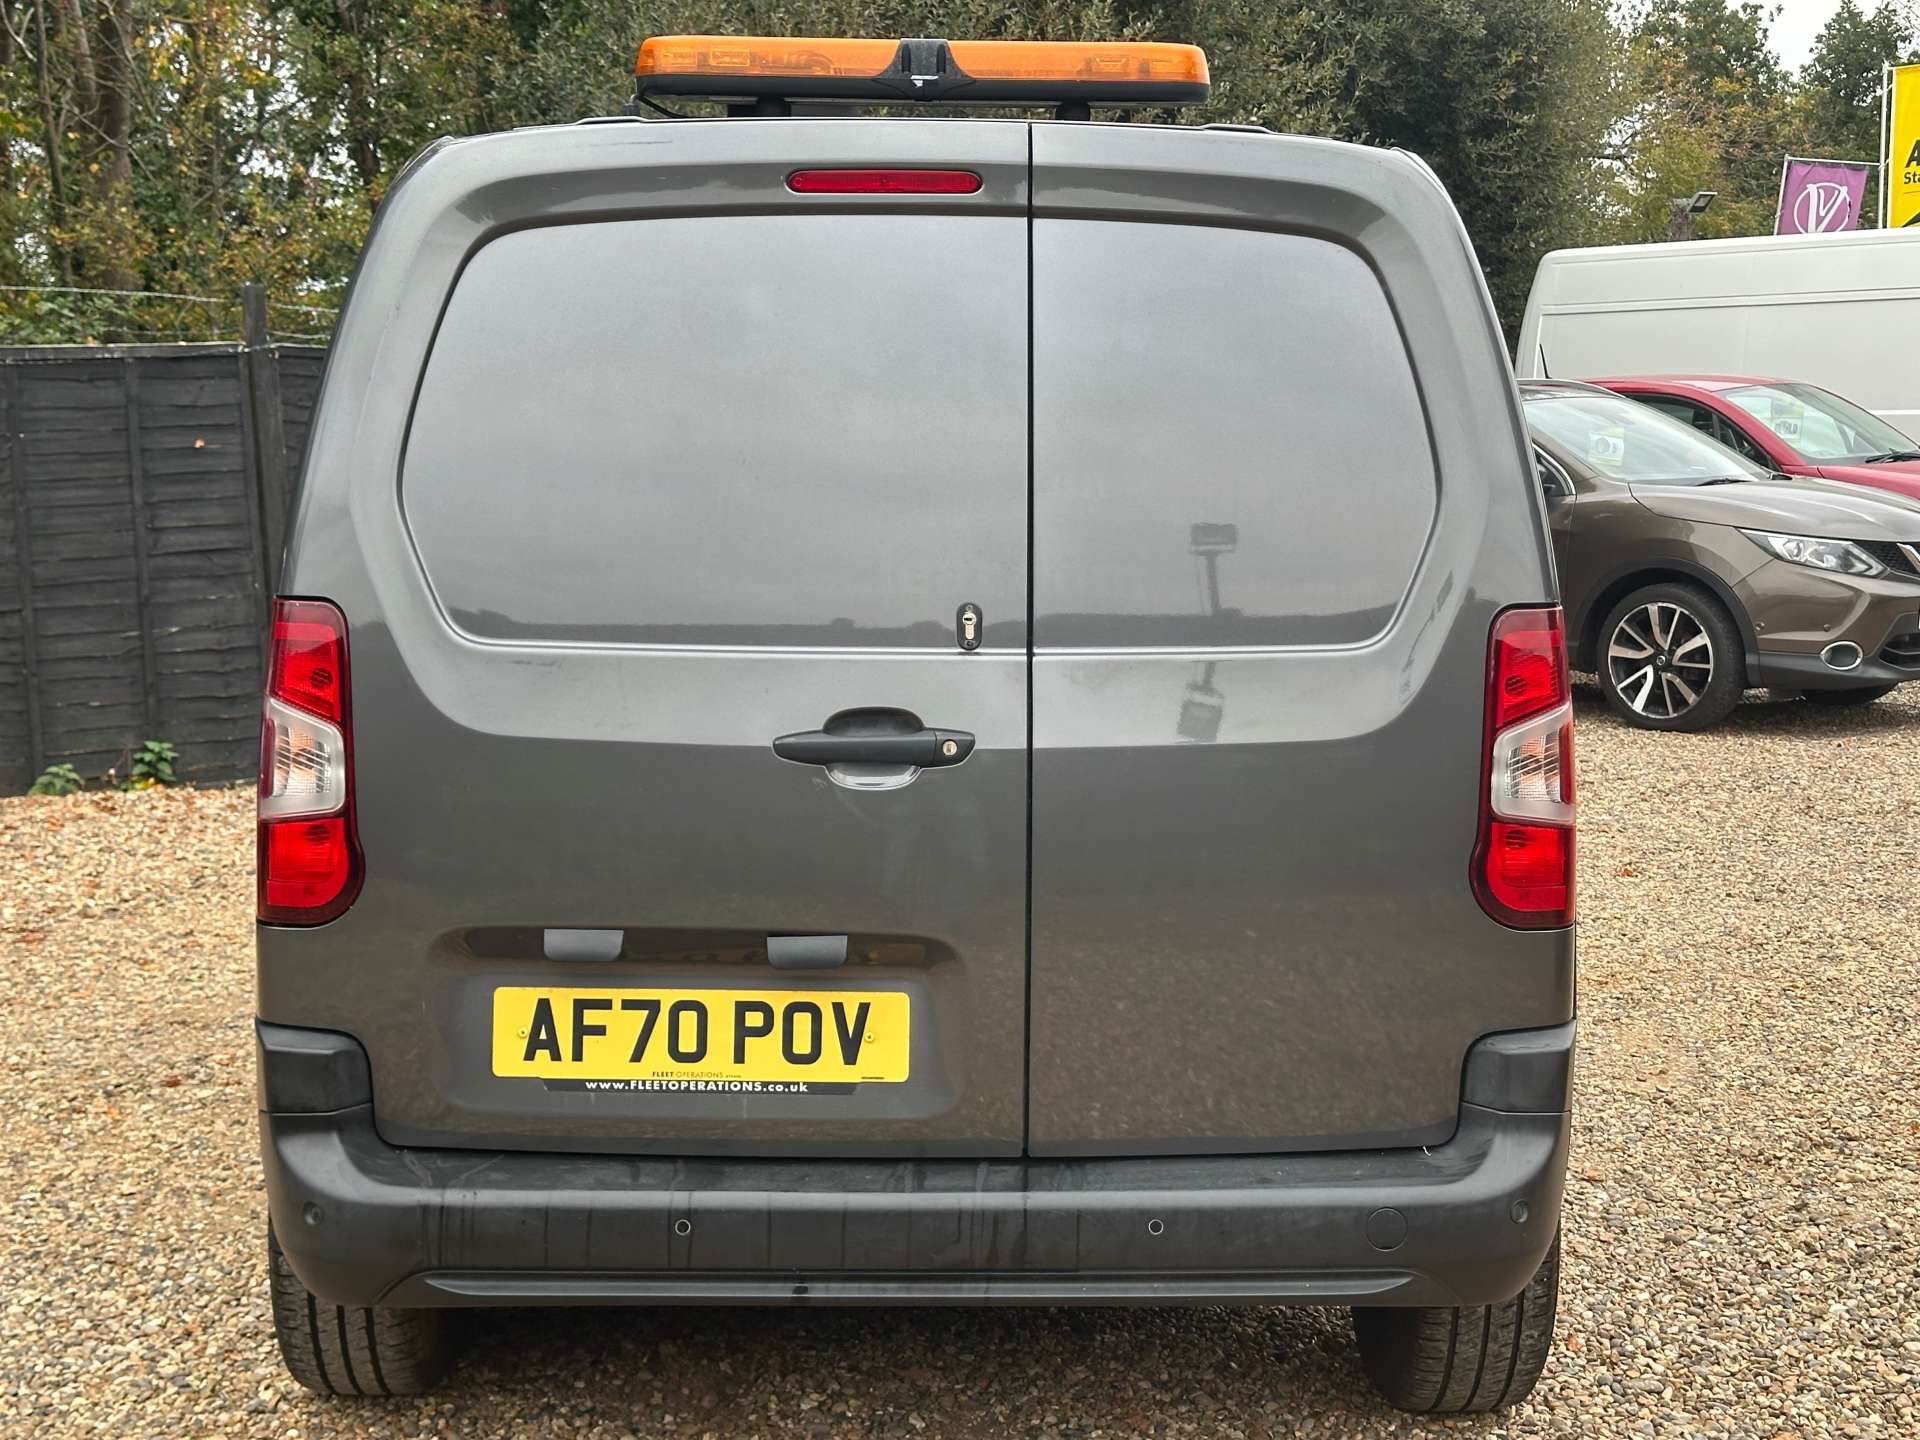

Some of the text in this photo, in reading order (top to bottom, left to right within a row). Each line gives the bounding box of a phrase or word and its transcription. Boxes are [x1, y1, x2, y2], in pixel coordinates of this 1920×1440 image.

[1904, 170, 1920, 184] St
[523, 997, 871, 1066] AF70 POV
[675, 1071, 724, 1079] OPERATIONS
[585, 1080, 808, 1092] www.FLEETOPERATIONS.co.uk
